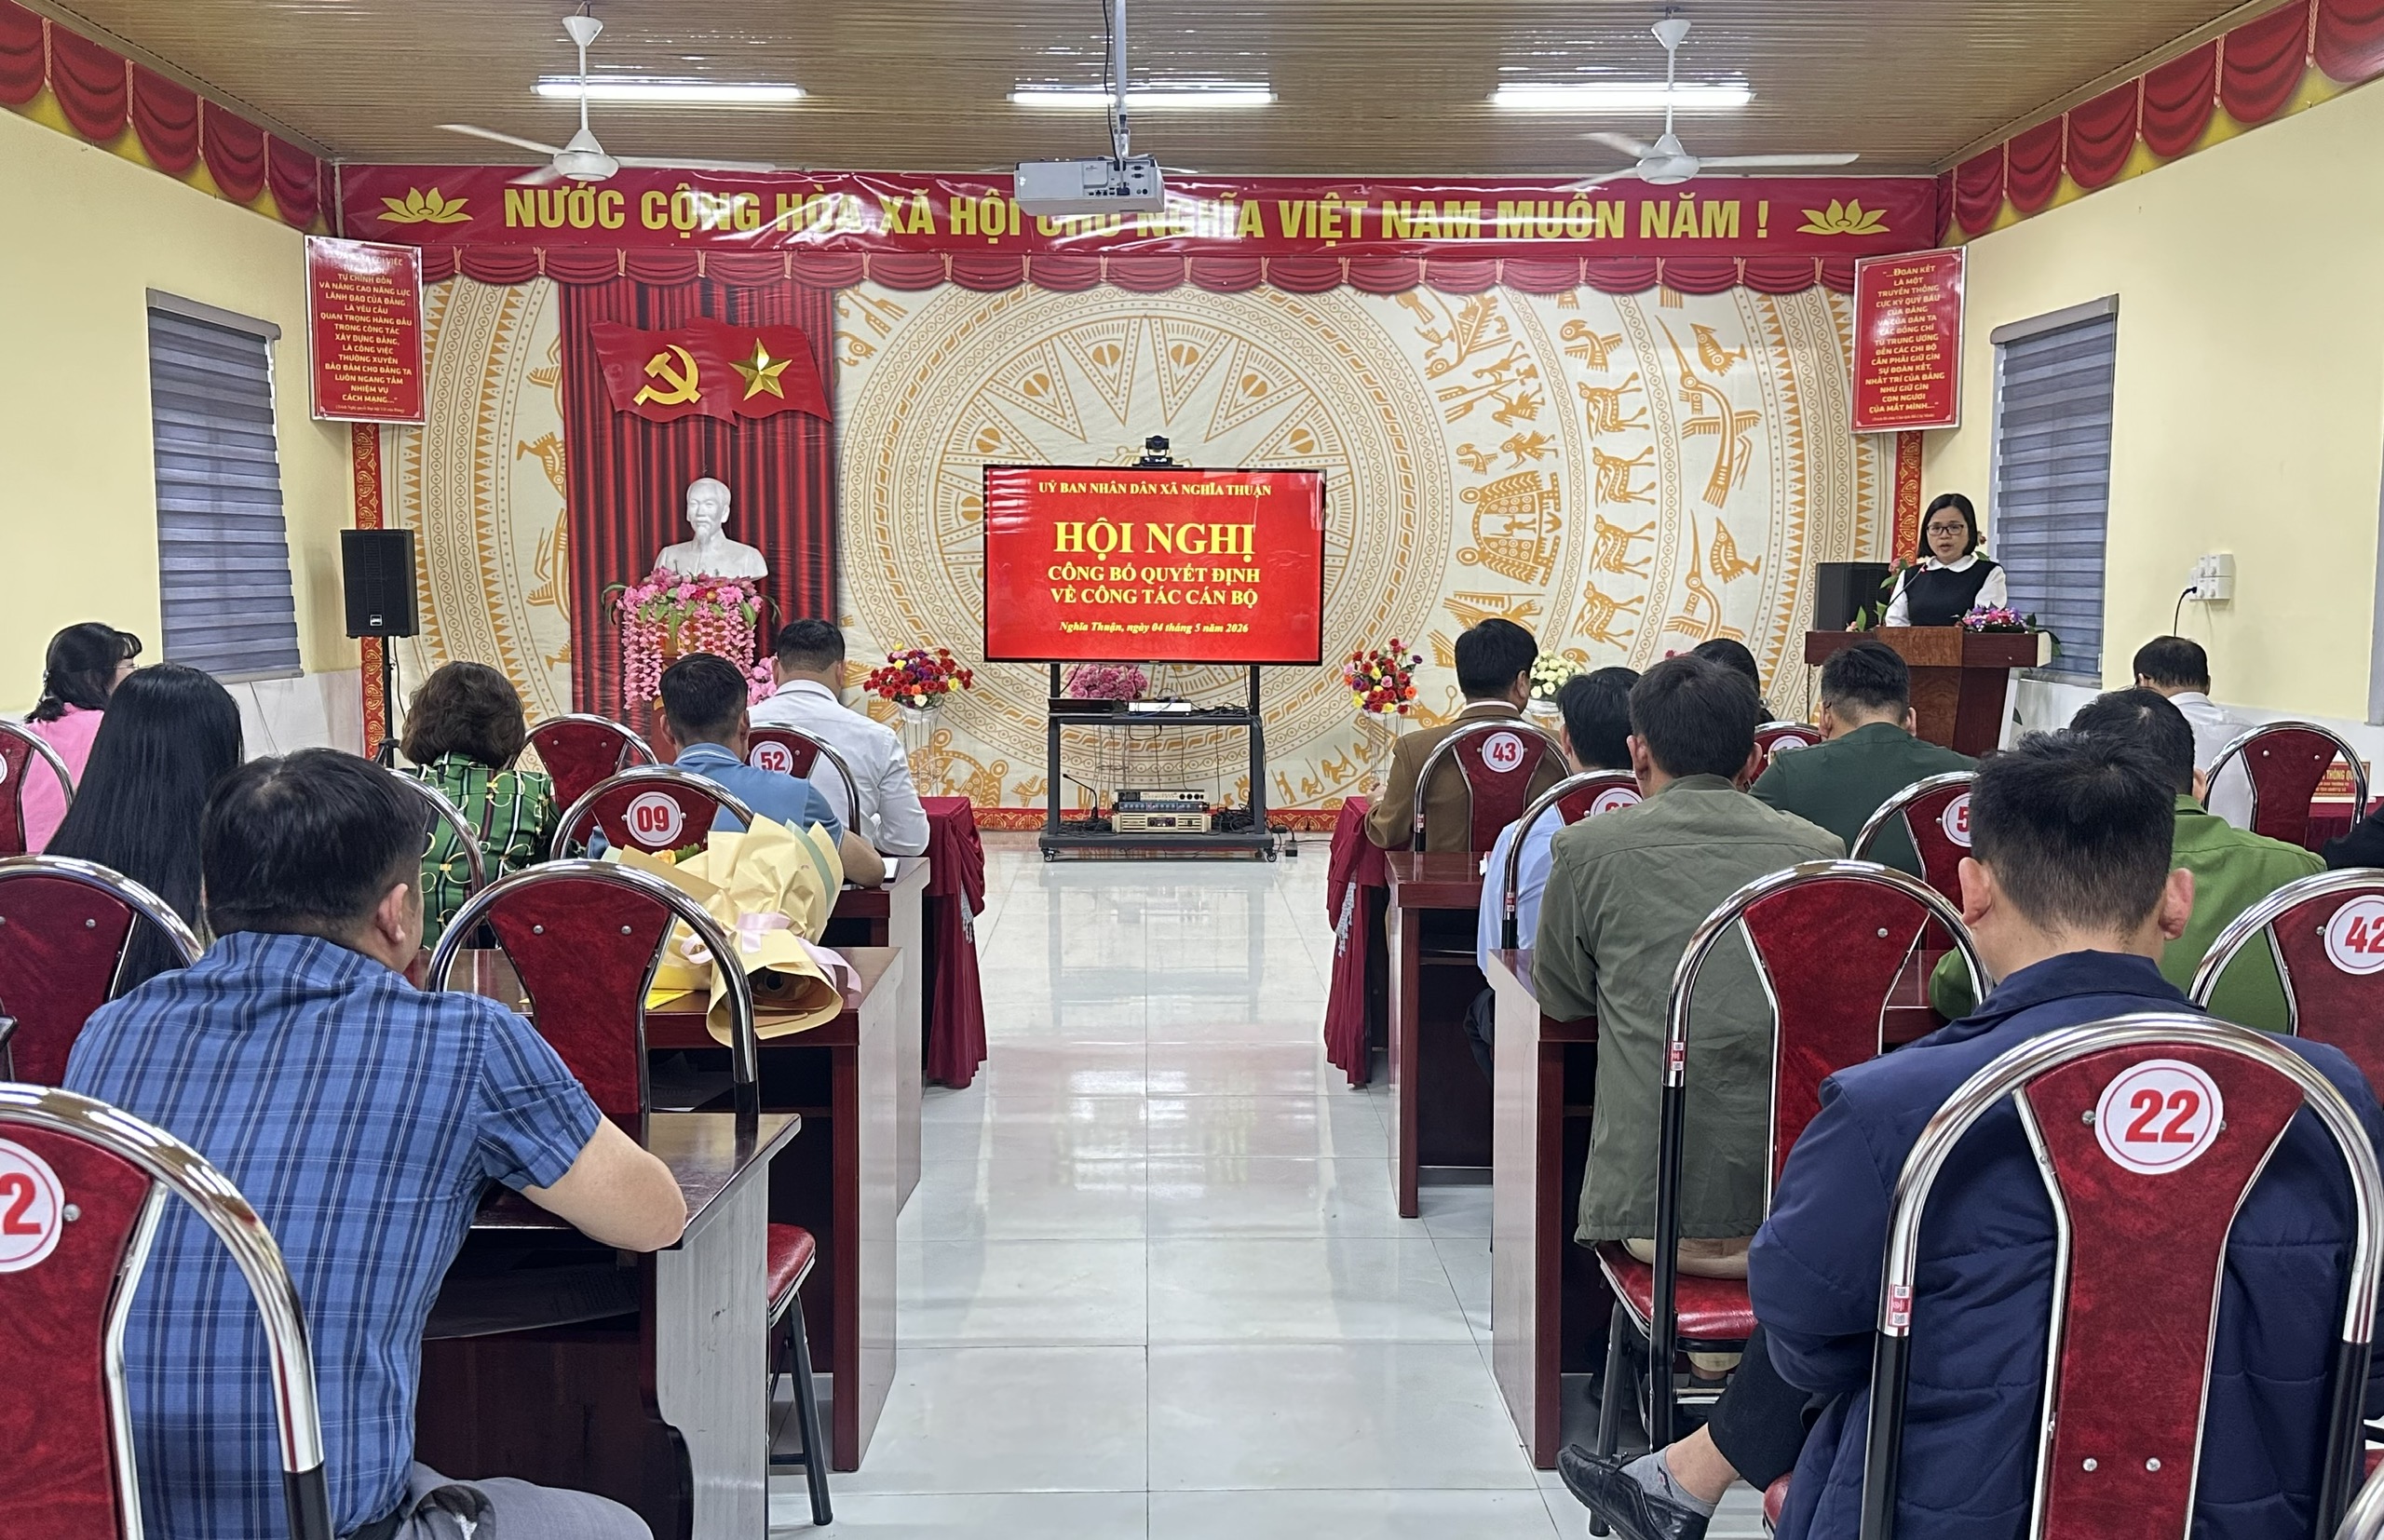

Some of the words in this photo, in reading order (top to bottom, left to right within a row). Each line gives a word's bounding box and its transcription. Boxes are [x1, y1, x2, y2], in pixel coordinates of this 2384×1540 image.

[504, 182, 625, 228] NƯỚC
[641, 183, 761, 238] CỘNG
[878, 188, 936, 236] XÃ
[950, 189, 1020, 244] HỘI
[1279, 192, 1368, 246] VIỆT
[1383, 200, 1481, 238] NAM
[1497, 193, 1623, 238] MUÔN
[1640, 192, 1739, 238] NĂM
[1755, 200, 1768, 238] !
[334, 323, 361, 331] TRONG
[363, 324, 383, 333] CÔNG
[385, 326, 400, 334] TÁC
[1060, 482, 1087, 494] BAN
[1089, 480, 1128, 494] NHÂN
[1130, 480, 1157, 495] DÂN
[1159, 481, 1179, 495] XÃ
[1181, 481, 1225, 495] NGHĨA
[1226, 482, 1271, 498] THUẬN
[1053, 517, 1134, 561] HỘI
[1145, 521, 1255, 563] NGHỊ
[1048, 561, 1105, 581] CÔNG
[1109, 561, 1137, 582] BỐ
[1141, 562, 1208, 585] QUYẾT
[1211, 568, 1261, 587] ĐỊNH
[1050, 584, 1077, 603] VỀ
[1080, 584, 1137, 604] CÔNG
[1141, 585, 1182, 604] TÁC
[1185, 586, 1226, 605] CÁN
[1230, 588, 1258, 609] BỘ
[1059, 621, 1089, 633] Nghĩa
[1090, 621, 1124, 633] Thuận,
[1126, 622, 1149, 634] ngày
[1151, 622, 1163, 632] 04
[1165, 622, 1193, 635] tháng
[1195, 623, 1201, 632] 5
[1202, 623, 1224, 632] năm
[1226, 623, 1249, 633] 2026
[761, 751, 785, 771] 52
[1493, 742, 1516, 762] 43
[637, 806, 670, 832] 09
[2345, 917, 2384, 953] 42
[2125, 1088, 2200, 1143] 22
